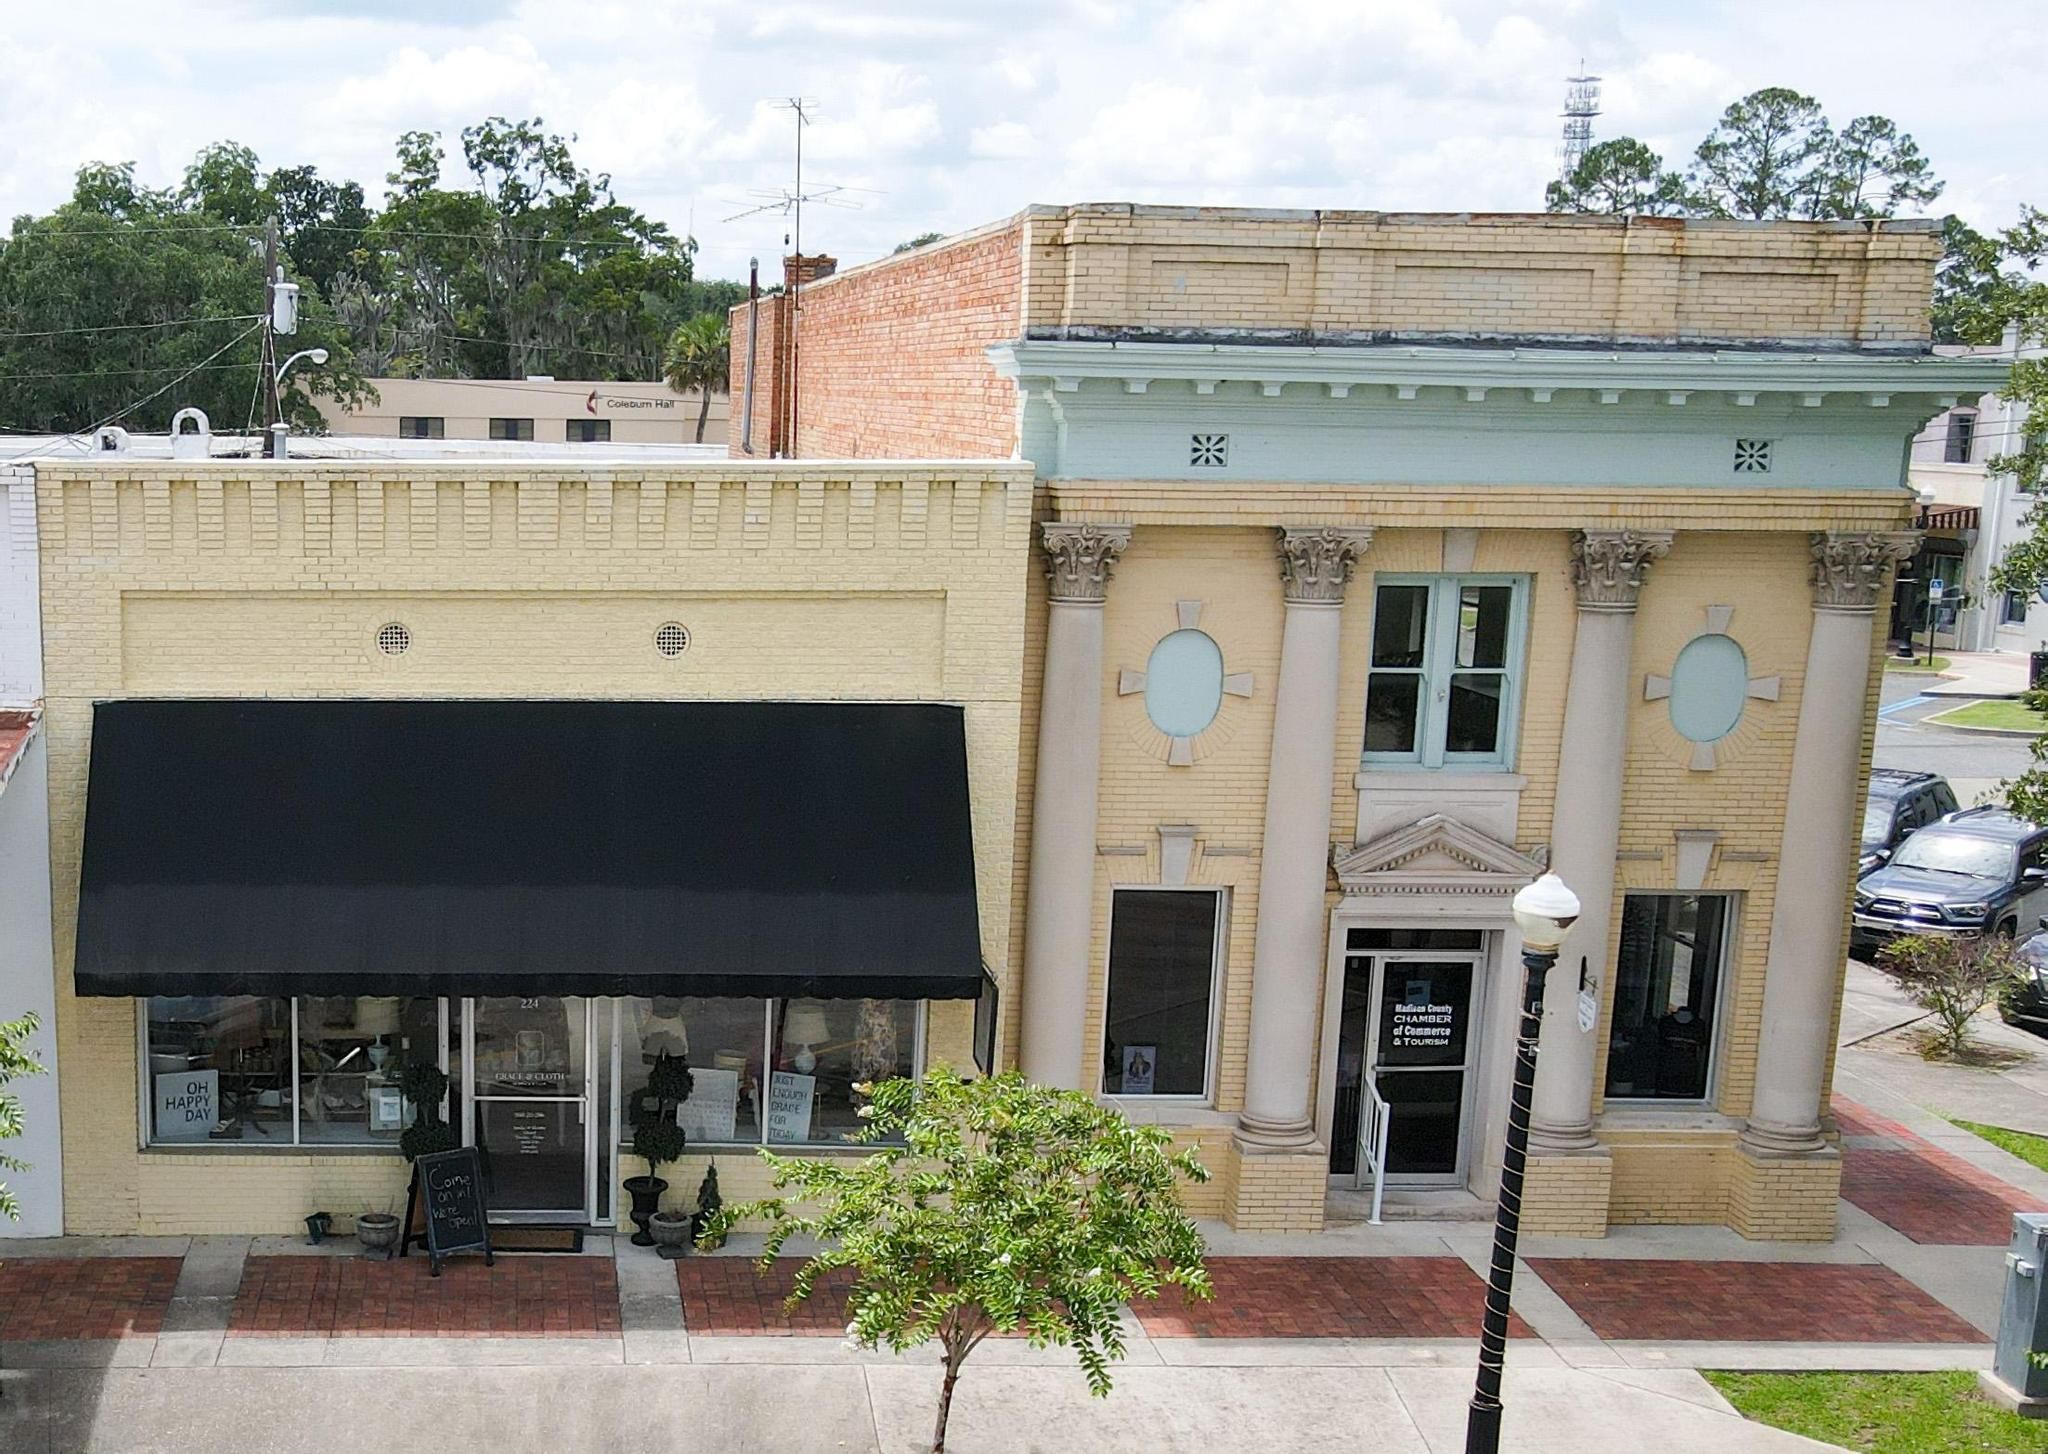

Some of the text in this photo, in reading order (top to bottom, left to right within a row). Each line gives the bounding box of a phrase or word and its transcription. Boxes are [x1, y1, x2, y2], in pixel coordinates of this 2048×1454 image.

[655, 399, 675, 409] Hall
[520, 998, 539, 1009] 224
[1395, 1004, 1453, 1014] Madison County
[1393, 1015, 1452, 1023] CHAMBER
[1392, 1025, 1451, 1036] of Commerce
[1392, 1038, 1401, 1046] &
[186, 1081, 209, 1095] OH
[165, 1095, 212, 1110] HAPPY
[185, 1108, 212, 1122] DAY
[429, 1164, 472, 1190] Come
[437, 1191, 454, 1203] on
